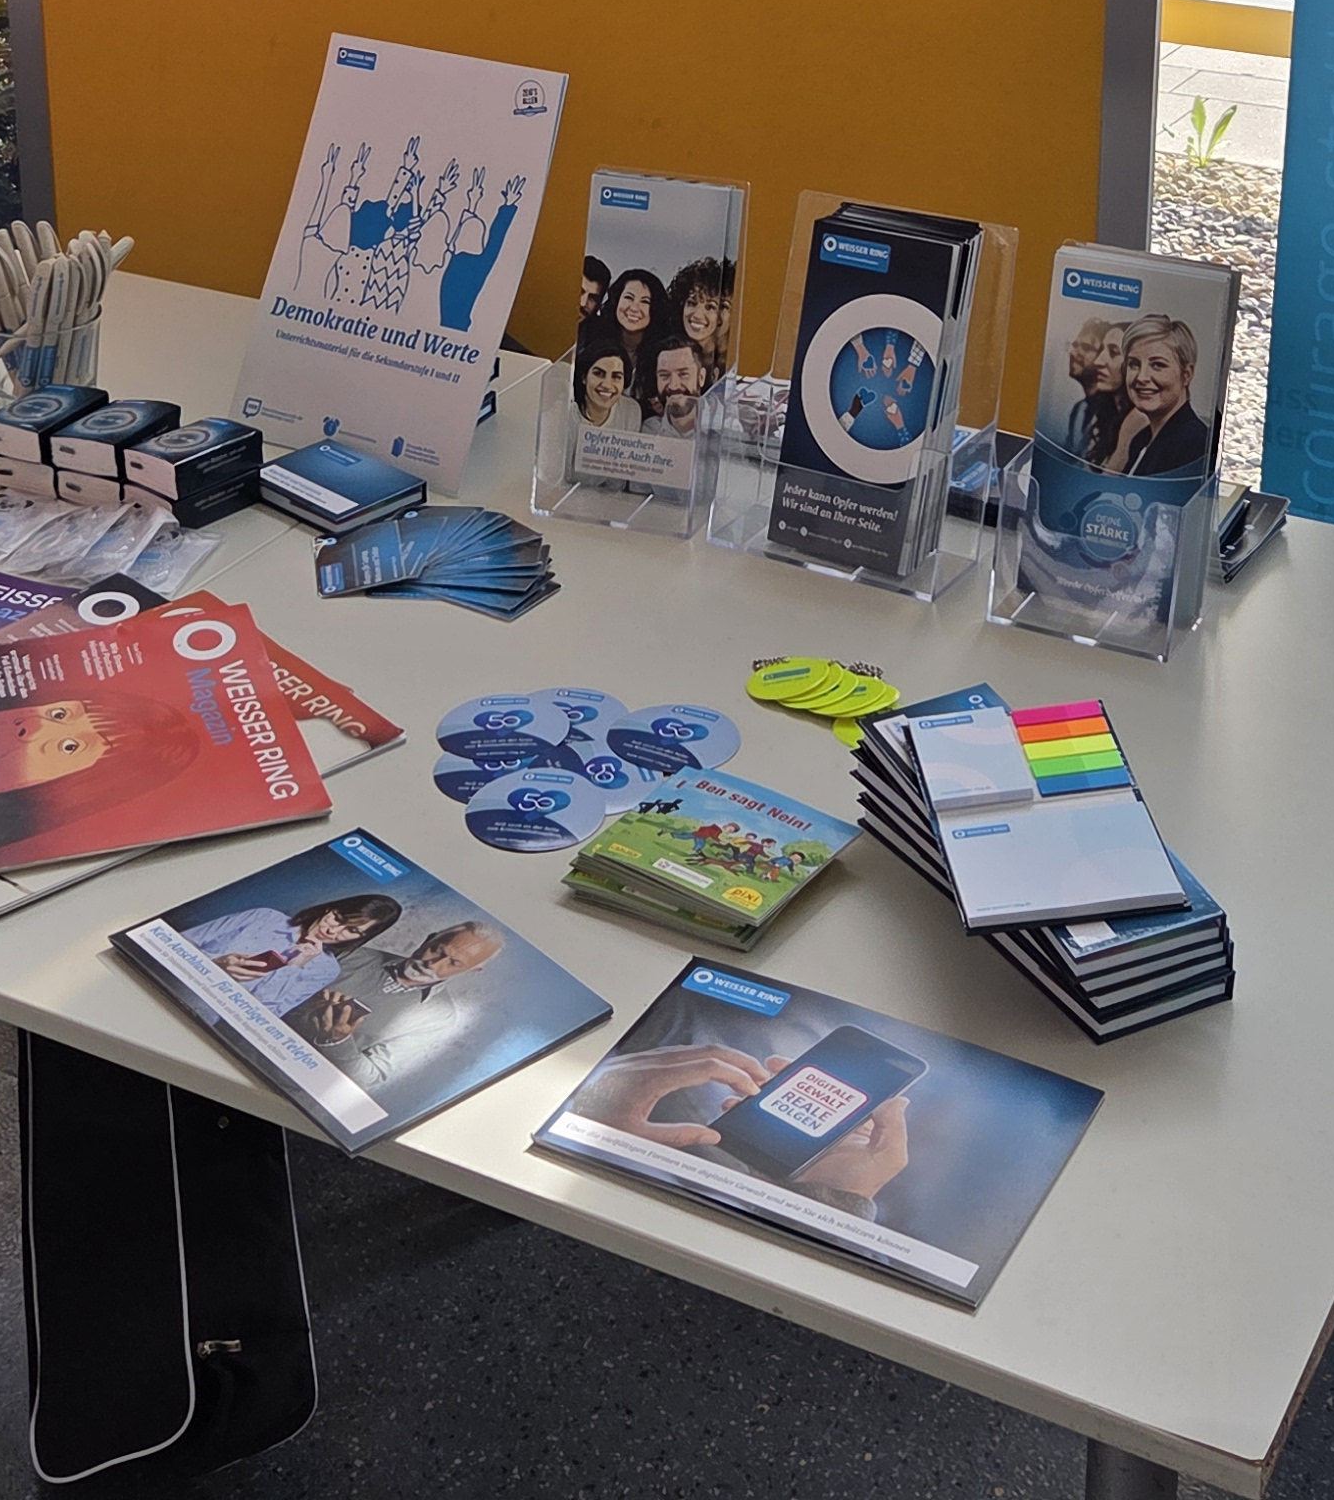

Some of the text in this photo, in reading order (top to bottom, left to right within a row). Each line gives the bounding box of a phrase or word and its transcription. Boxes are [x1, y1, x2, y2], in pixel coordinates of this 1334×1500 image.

[270, 296, 480, 364] Demokratie und Werte
[186, 667, 237, 746] Magazin
[218, 659, 299, 800] WEISSER RING
[695, 777, 812, 832] Ben sagt Nein!
[781, 1091, 833, 1122] REALE
[796, 1081, 846, 1110] GEWALT
[806, 1073, 856, 1102] DIGITALE
[770, 1100, 821, 1131] FOLGEN
